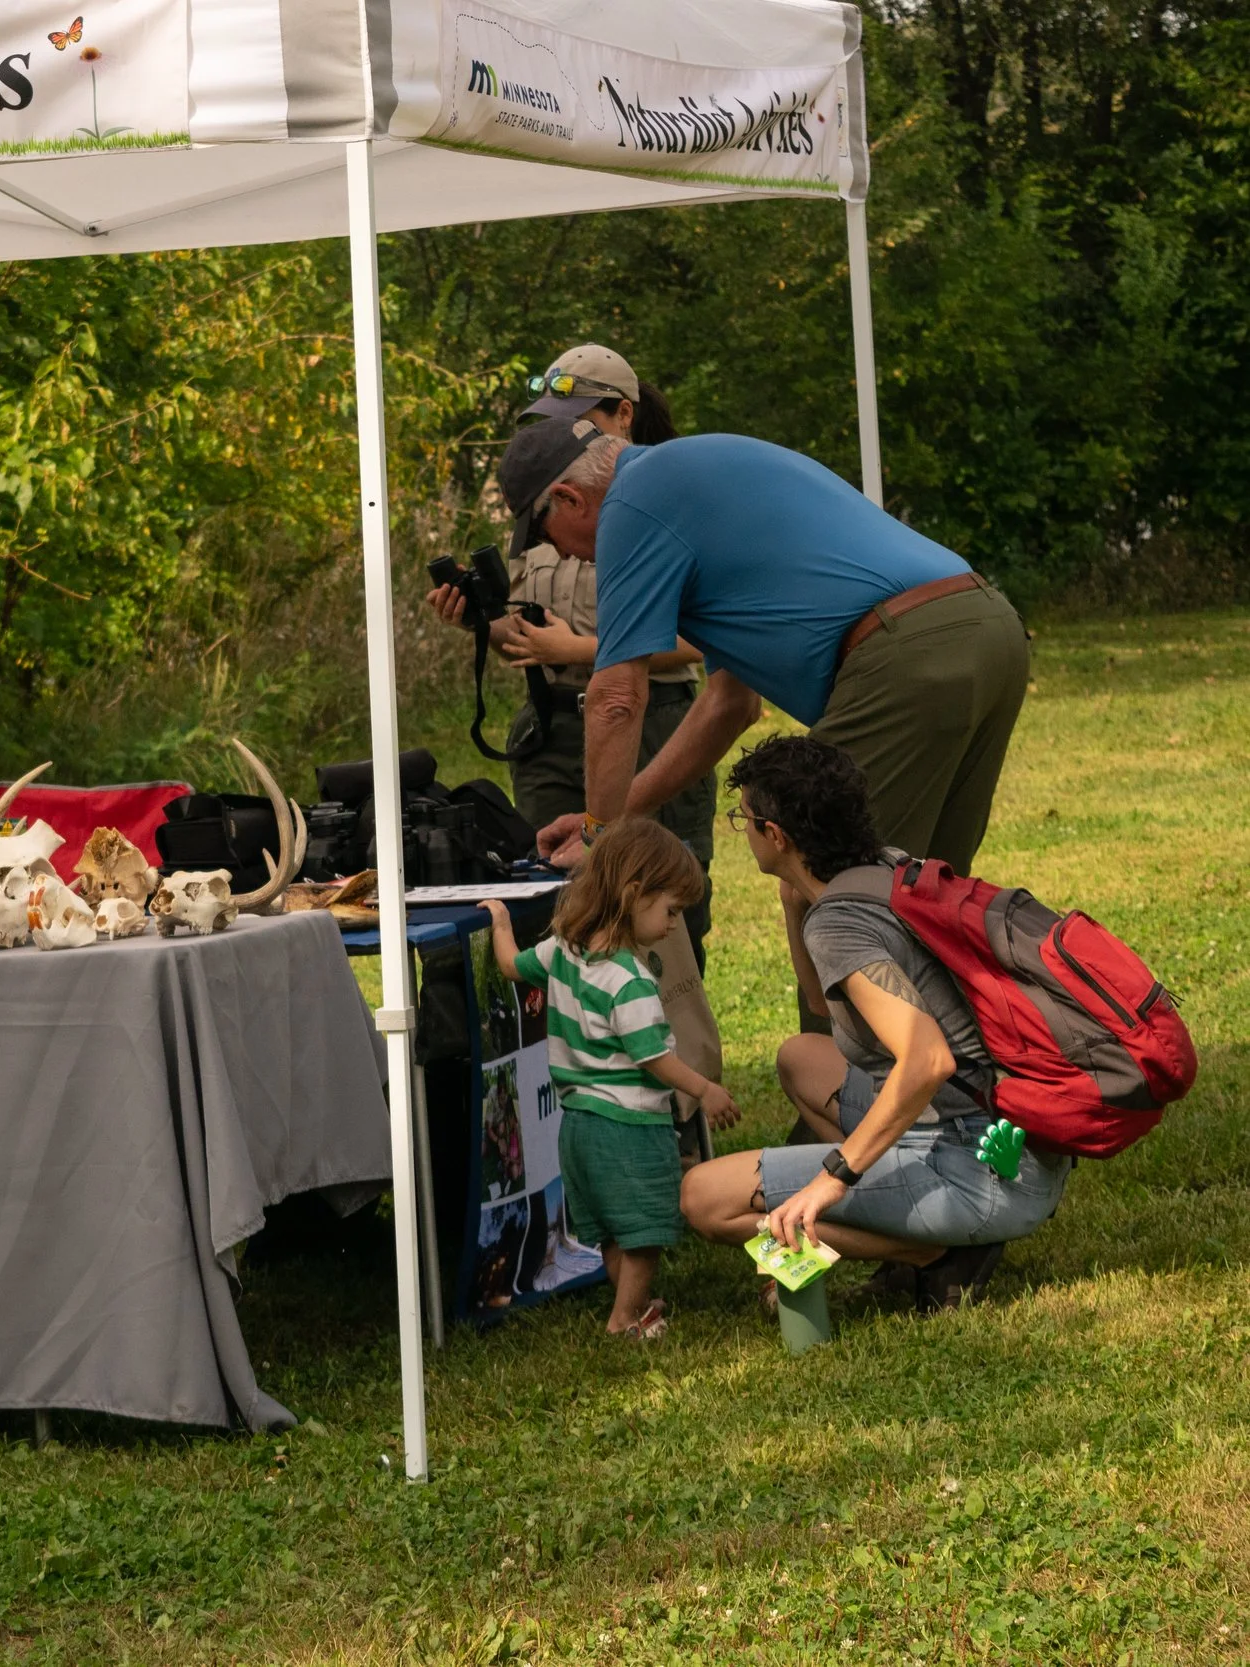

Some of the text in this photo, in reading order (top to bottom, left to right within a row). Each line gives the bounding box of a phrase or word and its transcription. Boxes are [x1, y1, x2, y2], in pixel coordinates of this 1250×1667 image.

[500, 79, 561, 114] MINNESOTA
[494, 111, 518, 127] STATE
[518, 116, 540, 133] PARKS
[540, 121, 555, 137] AND
